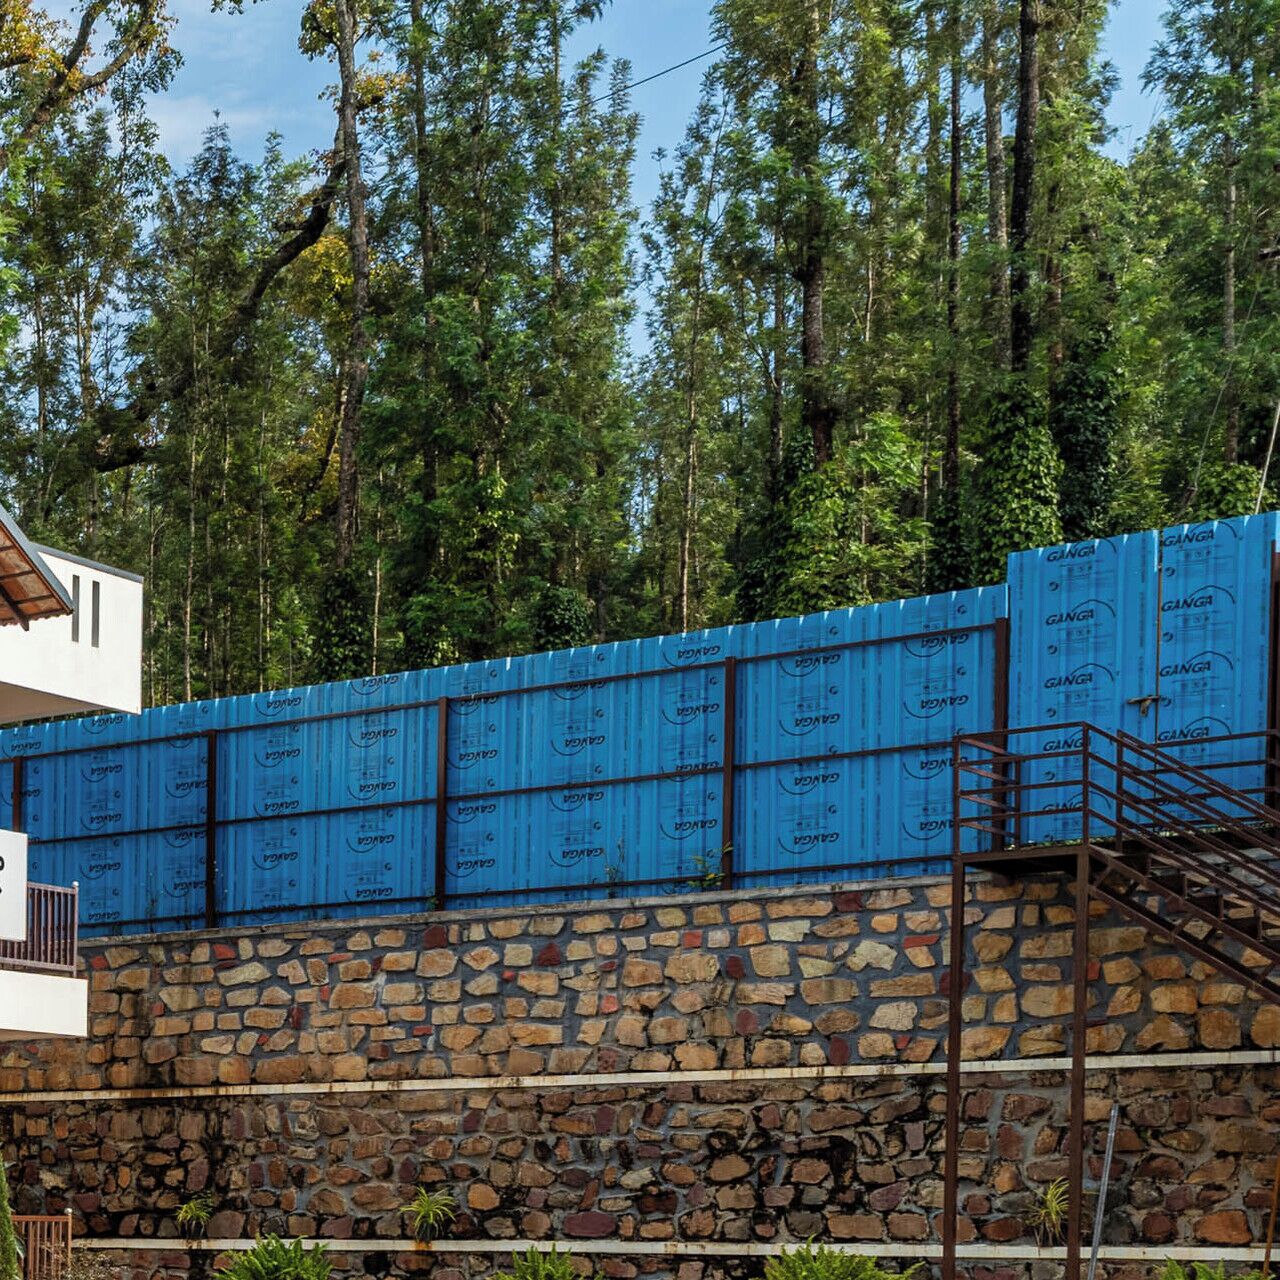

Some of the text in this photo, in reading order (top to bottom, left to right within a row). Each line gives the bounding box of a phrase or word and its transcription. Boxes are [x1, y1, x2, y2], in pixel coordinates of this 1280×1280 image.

[1163, 529, 1214, 547] GANGA
[1047, 545, 1096, 562] GANGA
[1161, 595, 1213, 613] GANGA
[1046, 609, 1094, 626] GANGA
[921, 633, 969, 649] GANGA
[677, 645, 721, 659] GANGA
[795, 653, 841, 669] GANGA
[1160, 661, 1211, 678] GANGA
[1044, 672, 1093, 689] GANGA
[676, 703, 720, 717] GANGA
[920, 694, 969, 711] GANGA
[795, 712, 841, 728] GANGA
[360, 727, 398, 741] GANGA
[565, 735, 606, 748] GANGA
[1158, 726, 1210, 742] GANGA
[1043, 737, 1085, 752] GANG
[265, 748, 301, 761] GANGA
[459, 749, 498, 762] GANGA
[359, 781, 397, 793] GANGA
[794, 772, 840, 787] GANGA
[563, 791, 604, 804] GANGA
[457, 803, 496, 816] GANGA
[675, 818, 717, 831] GANGA
[357, 834, 395, 846] GANGA
[793, 831, 840, 846] GANGA
[263, 851, 299, 863] GANGA
[456, 858, 495, 870] GANGA
